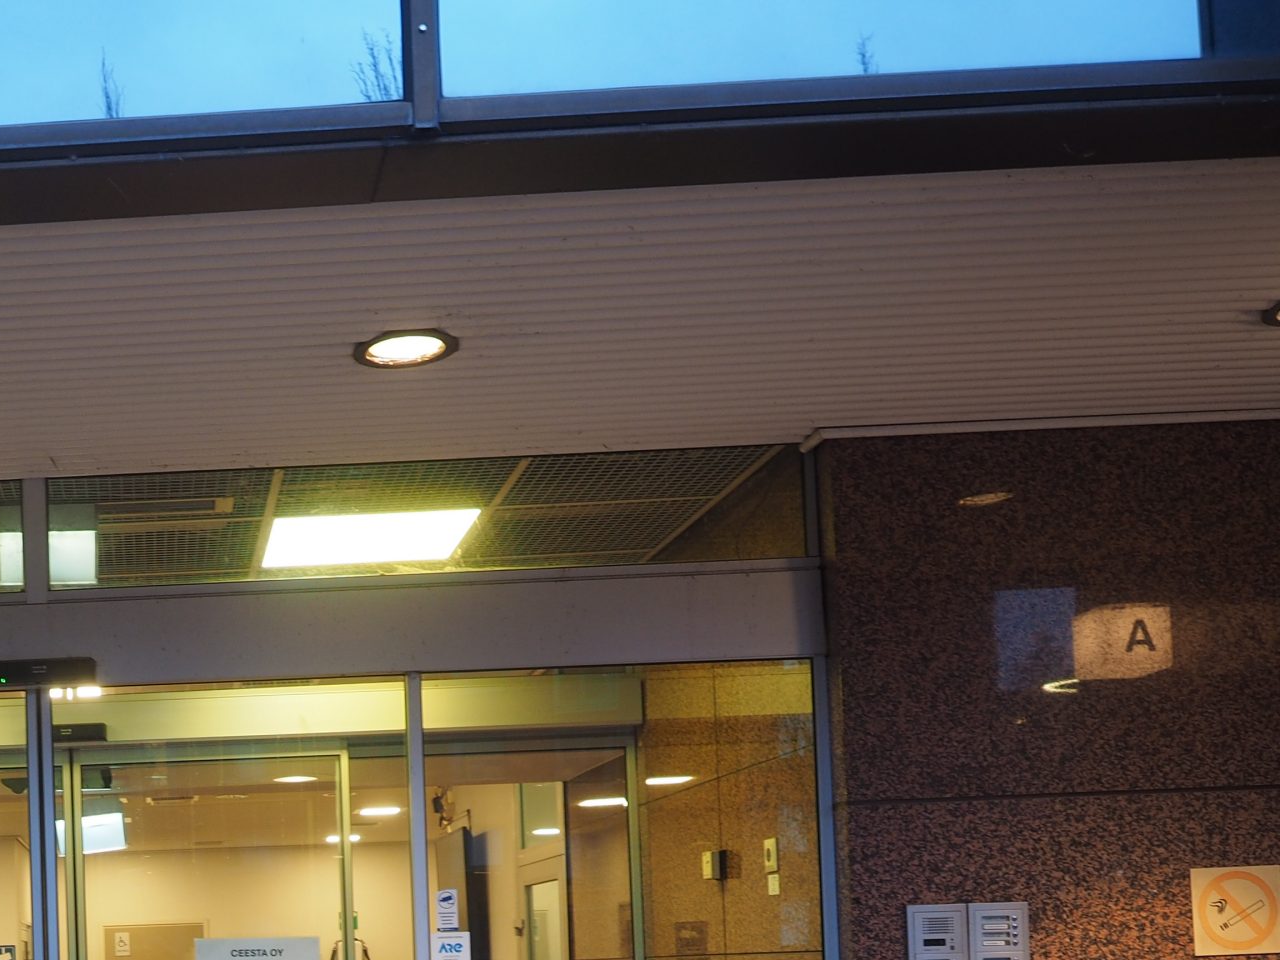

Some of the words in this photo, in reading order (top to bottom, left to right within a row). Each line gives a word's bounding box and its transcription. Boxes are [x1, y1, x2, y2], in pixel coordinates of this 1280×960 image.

[1125, 619, 1156, 652] A
[230, 949, 268, 957] CEESTA
[270, 948, 284, 957] OY
